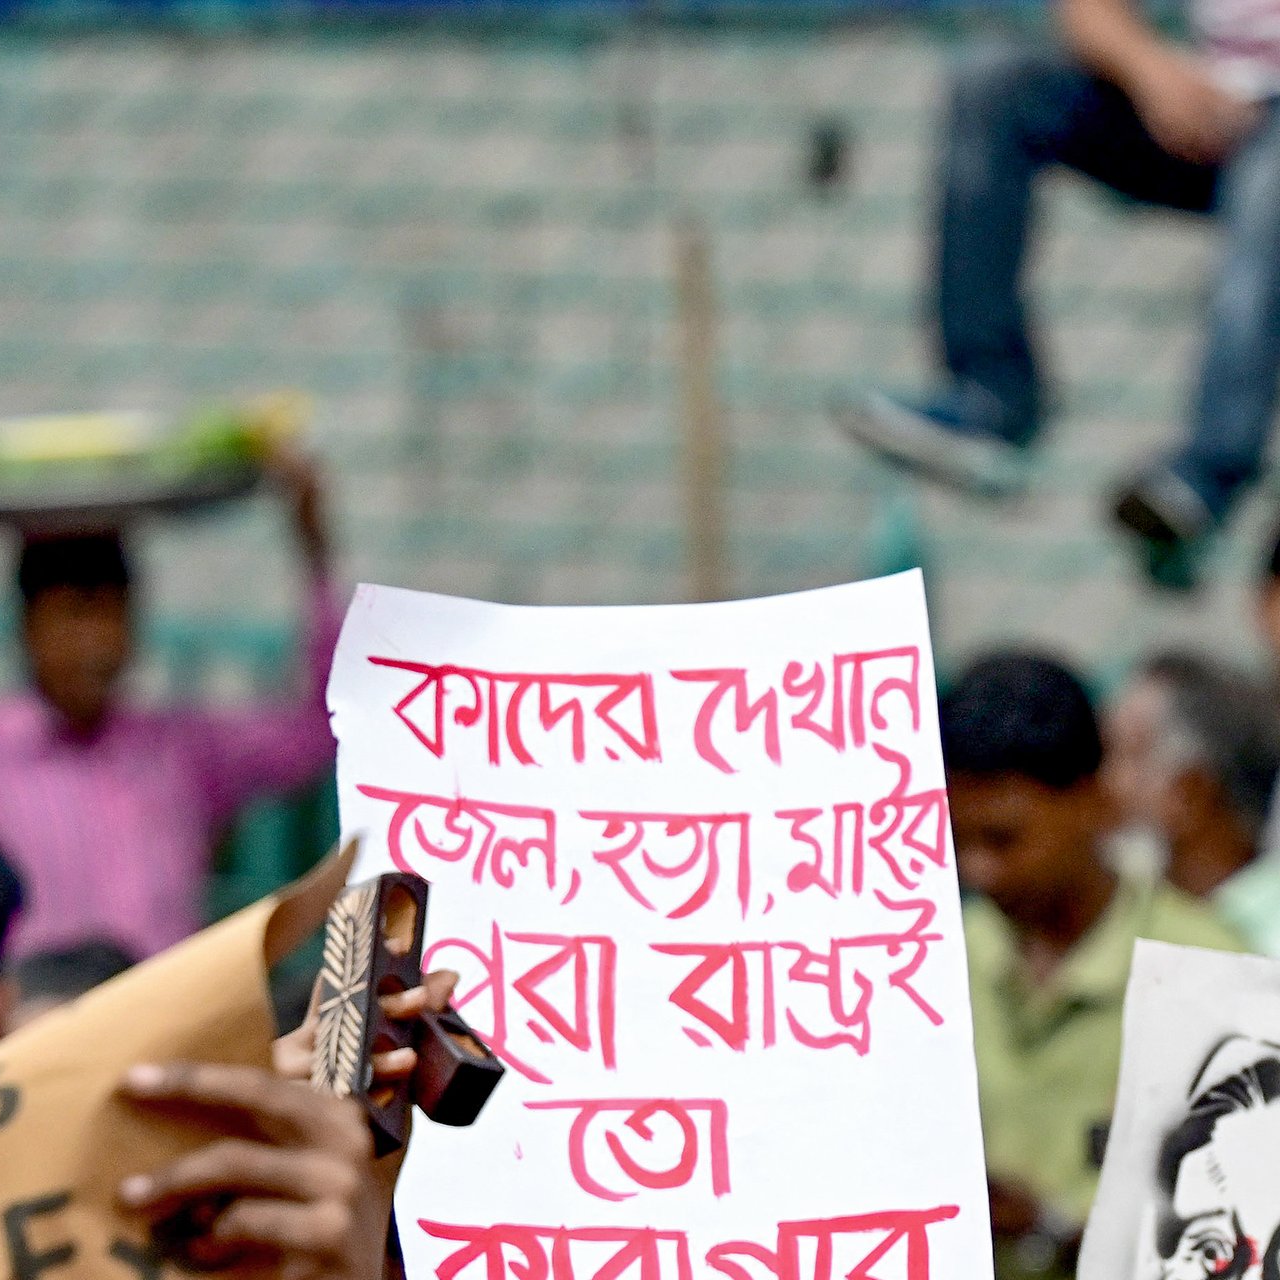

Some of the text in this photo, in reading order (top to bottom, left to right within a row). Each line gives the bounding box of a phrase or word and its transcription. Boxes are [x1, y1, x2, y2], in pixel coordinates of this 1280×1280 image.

[366, 645, 921, 774] কাদের দেখান
[523, 1098, 728, 1200] তো
